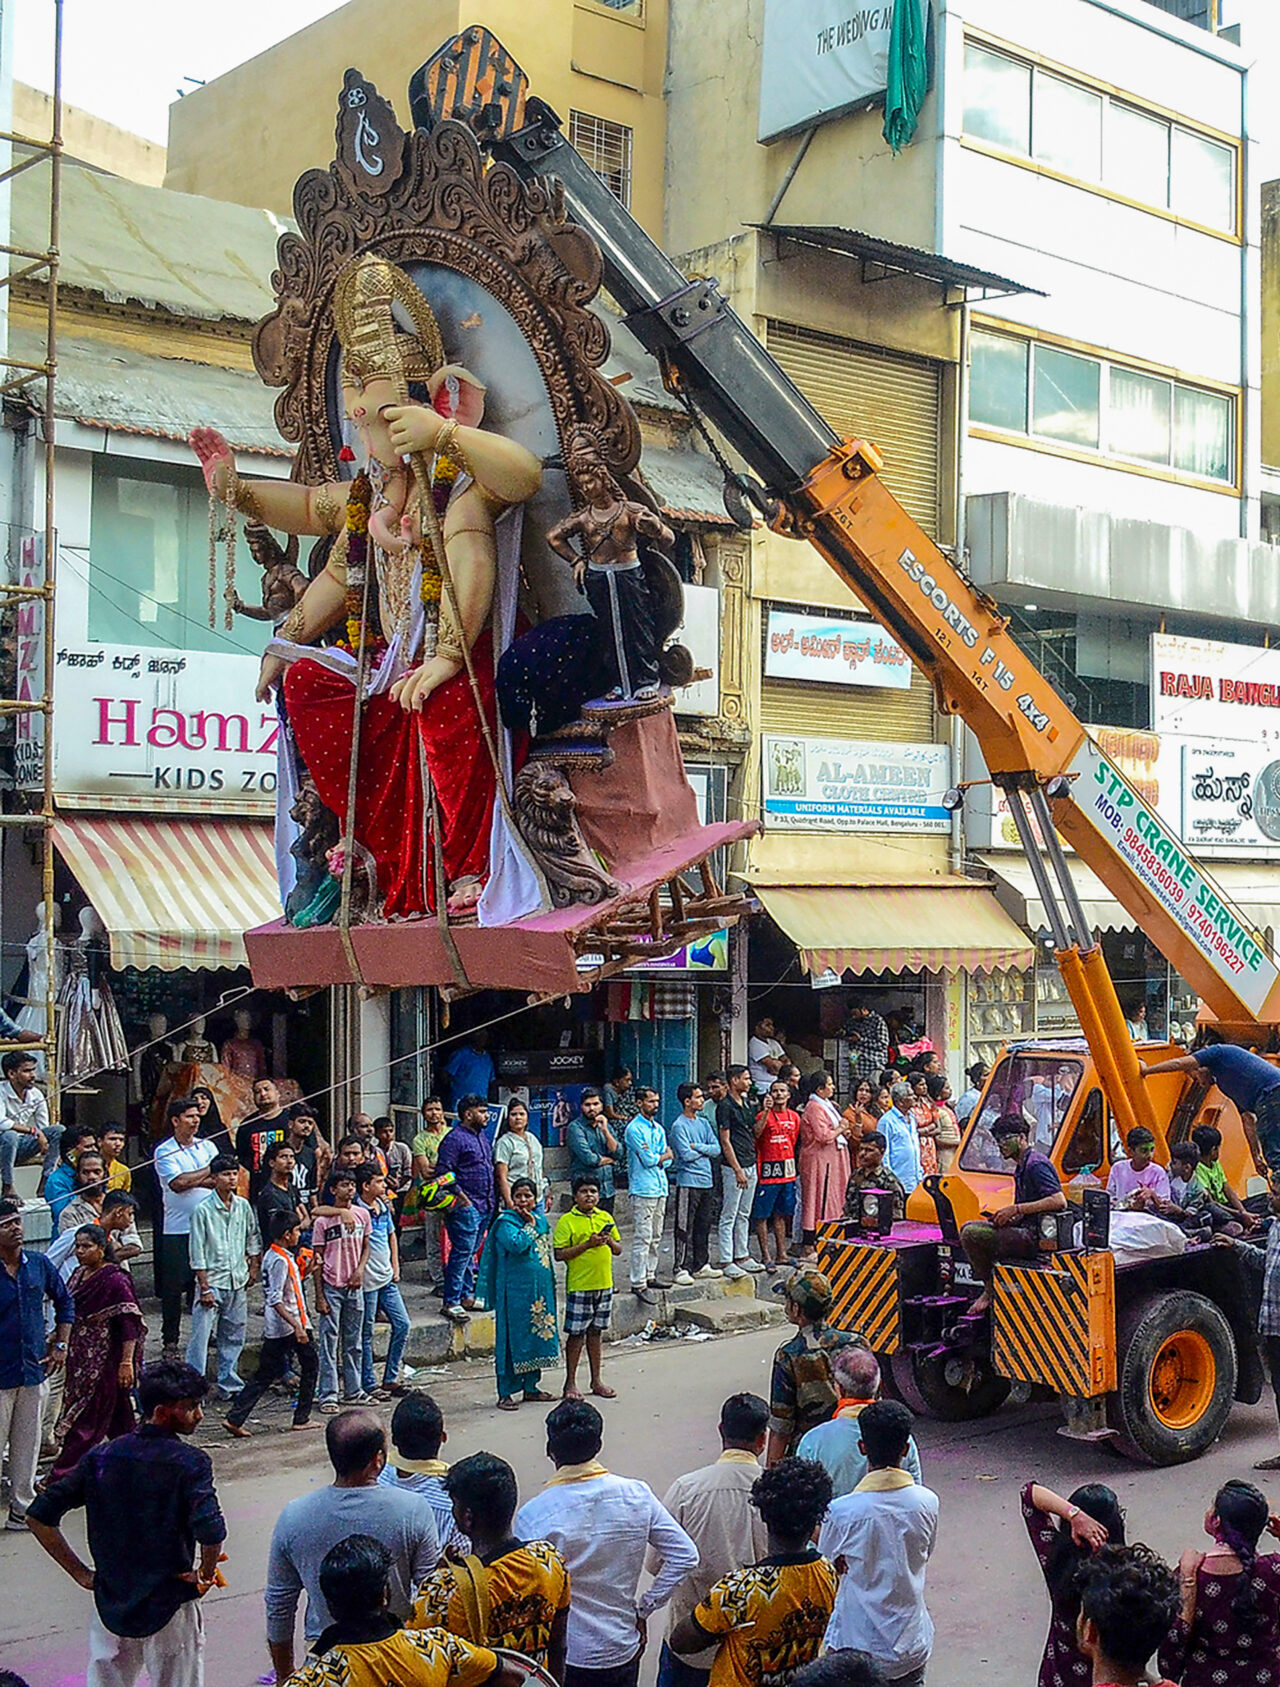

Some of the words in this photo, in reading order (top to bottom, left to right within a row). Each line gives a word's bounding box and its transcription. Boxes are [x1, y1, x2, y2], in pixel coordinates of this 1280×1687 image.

[816, 27, 835, 55] THE
[897, 546, 980, 649] ESCORTS
[1016, 693, 1050, 733] 4x4
[971, 671, 989, 692] 14T
[1160, 671, 1214, 700] RAJA
[15, 764, 39, 784] ONE
[154, 766, 224, 791] KIDS
[240, 771, 277, 793] ZO
[816, 761, 932, 788] AL-AMEEN
[822, 785, 870, 802] CLOTH
[795, 803, 835, 813] UNIFORM
[836, 805, 883, 814] MATERIALS
[883, 806, 926, 816] AVAILABLE
[1117, 839, 1135, 866] Email:
[1093, 761, 1135, 809] STP
[1136, 810, 1196, 890] CRANE
[1194, 884, 1265, 972] SERVICE
[1094, 793, 1124, 834] MOB:
[1122, 827, 1184, 904] 9845836039
[1187, 904, 1245, 975] 9740196227
[550, 1056, 585, 1065] JOCKEY
